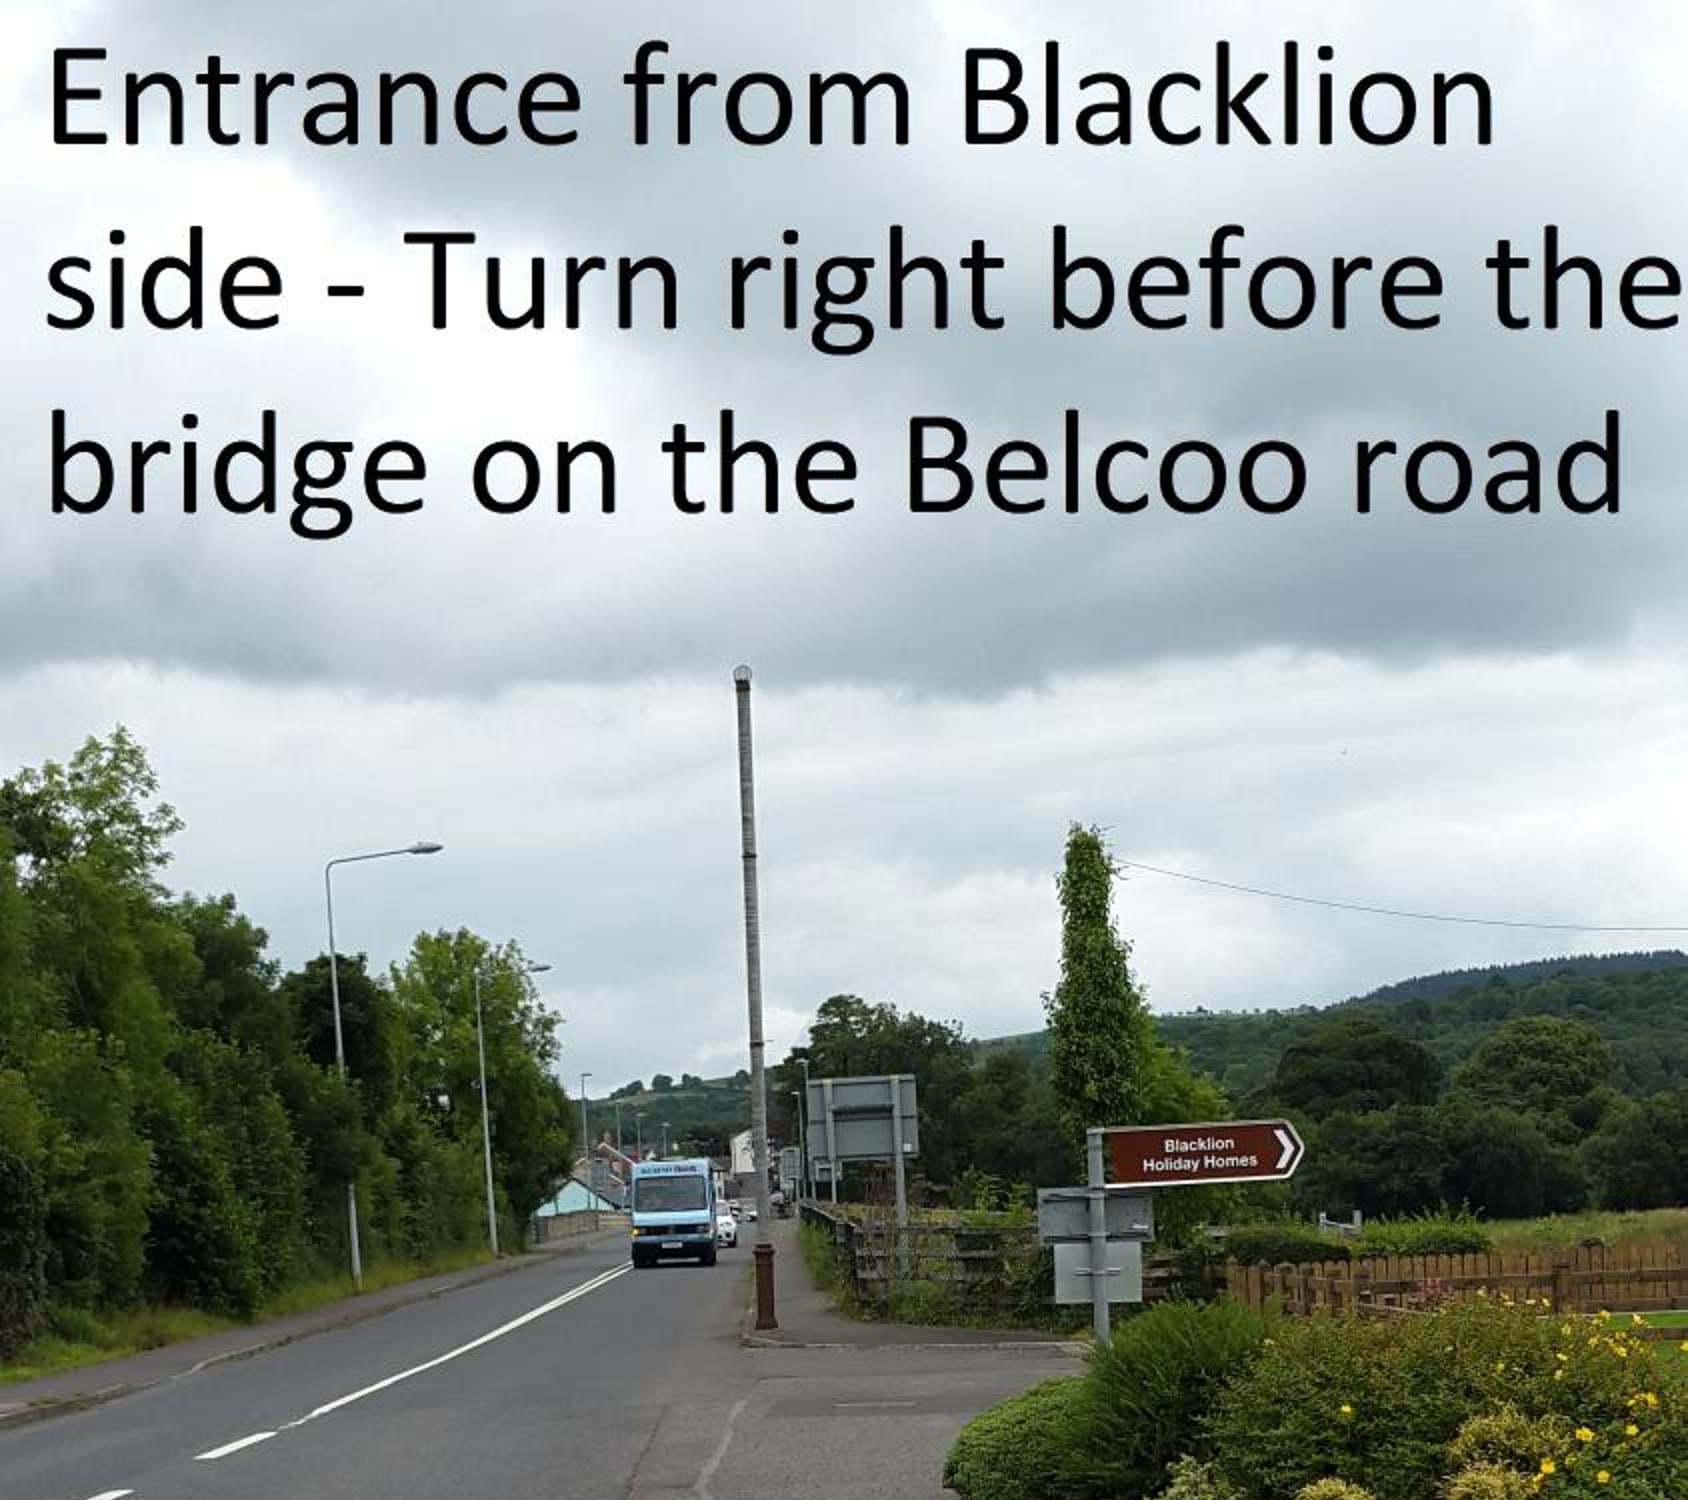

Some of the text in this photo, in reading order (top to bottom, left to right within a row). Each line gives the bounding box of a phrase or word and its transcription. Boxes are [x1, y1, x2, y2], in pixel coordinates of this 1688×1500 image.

[1164, 1138, 1235, 1153] Blacklion
[1143, 1155, 1258, 1172] Holiday Homes
